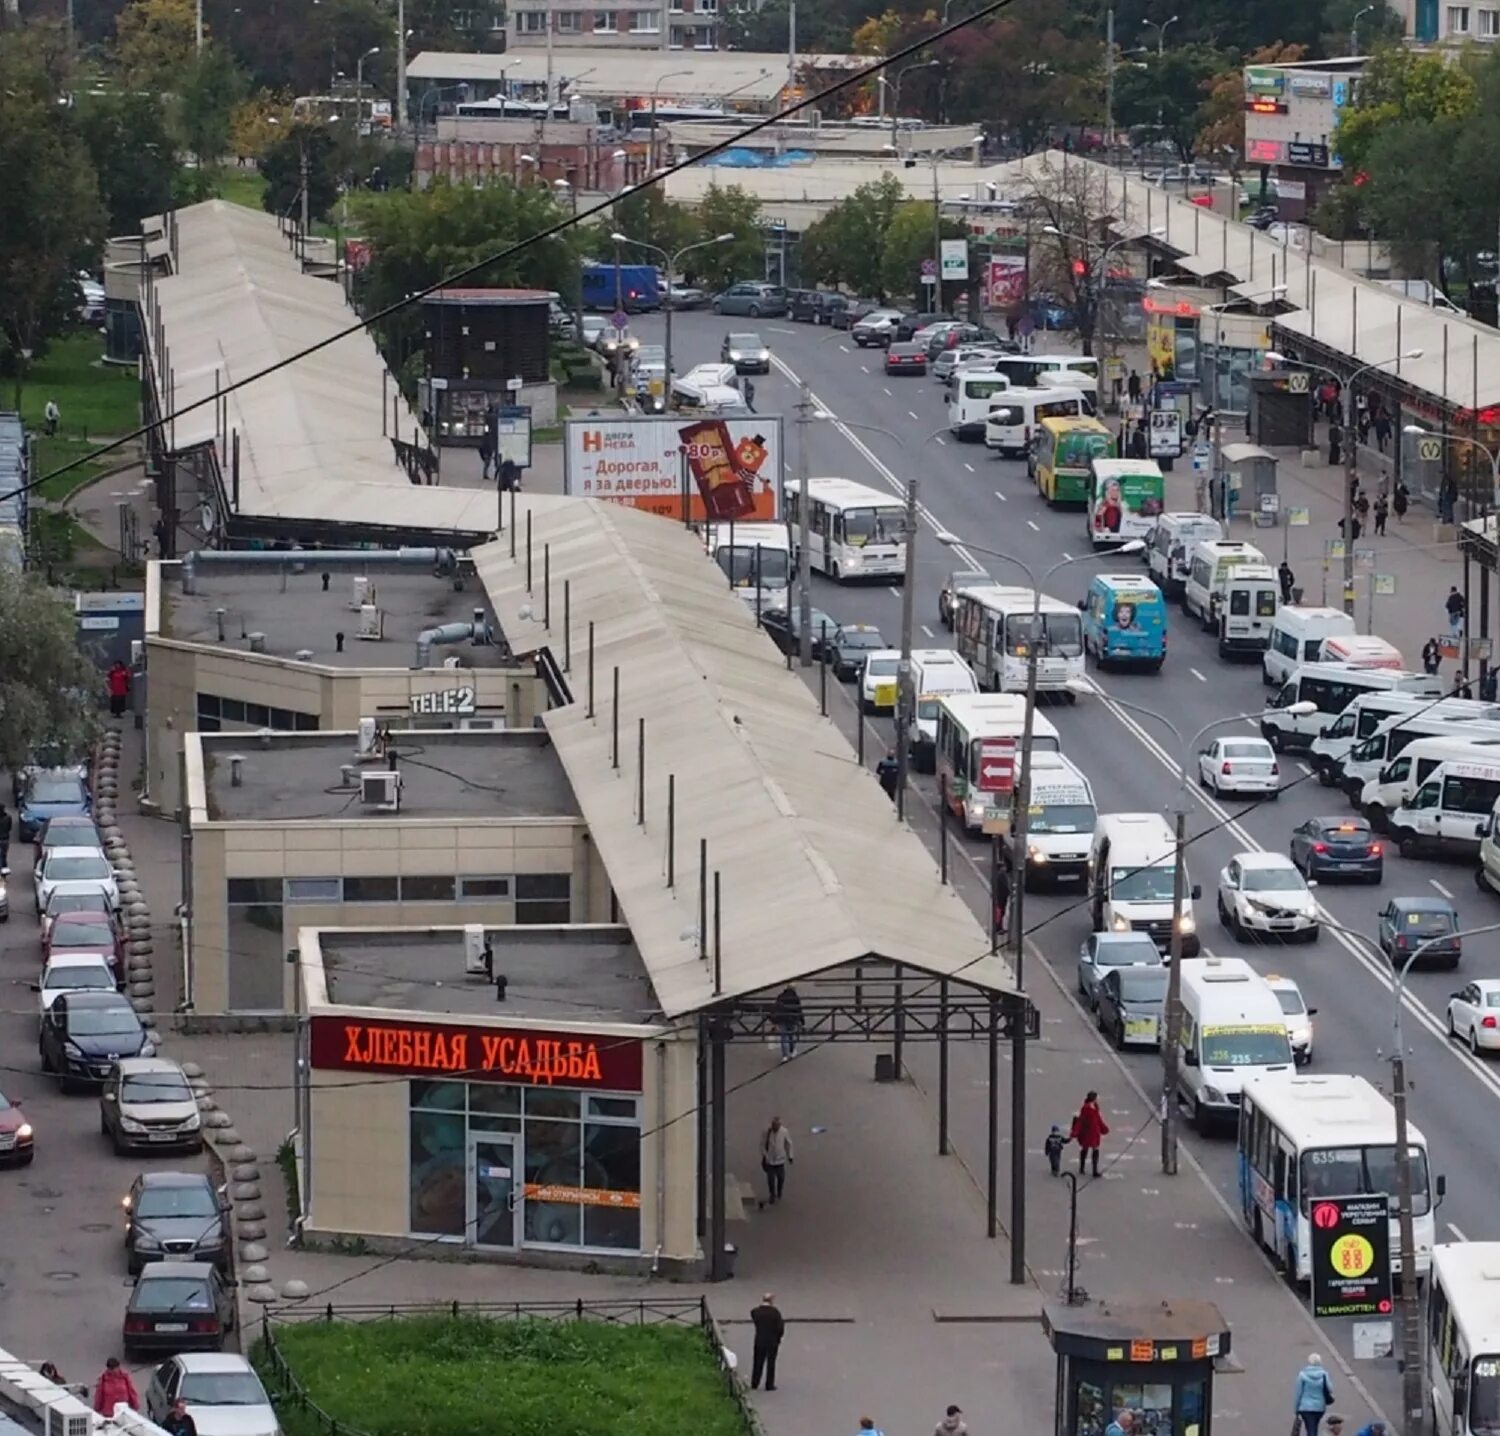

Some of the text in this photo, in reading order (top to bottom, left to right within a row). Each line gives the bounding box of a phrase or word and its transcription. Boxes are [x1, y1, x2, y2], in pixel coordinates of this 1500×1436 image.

[596, 460, 662, 475] Дорогая,
[584, 476, 677, 491] я за дверью!
[410, 687, 474, 713] TELE2
[344, 1026, 602, 1084] ХЛЕБНАЯ УСАДЬБА
[1231, 1054, 1252, 1064] 235
[1312, 1151, 1335, 1165] 635
